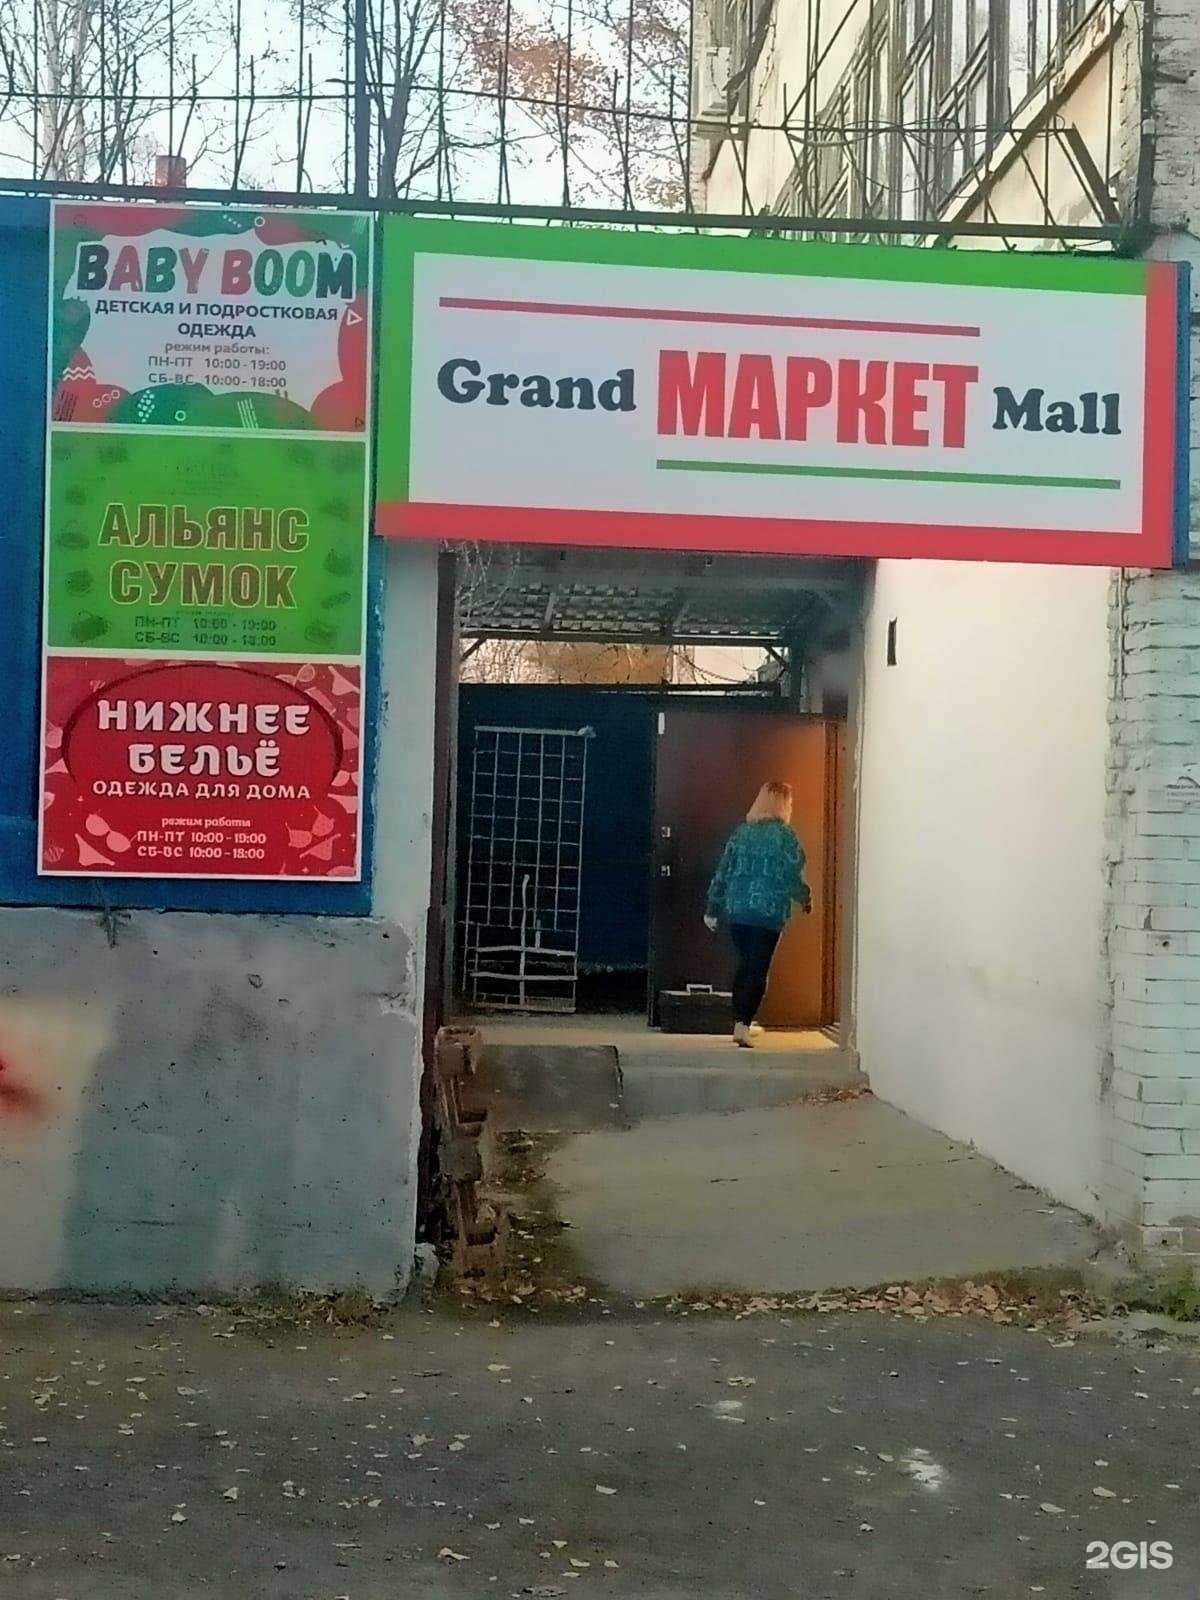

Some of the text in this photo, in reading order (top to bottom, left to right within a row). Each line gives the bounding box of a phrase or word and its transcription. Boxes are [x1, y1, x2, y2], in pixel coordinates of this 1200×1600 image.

[77, 244, 353, 299] BABY BOOM
[95, 299, 338, 320] ДЕТСКАЯ И ПОДРОСТКОВАЯ
[178, 323, 256, 338] ОДЕЖДА
[165, 343, 270, 355] режим работы:
[148, 356, 193, 367] ПН-ПТ
[204, 358, 240, 368] 10:00
[251, 360, 286, 371] 19:00
[148, 373, 194, 384] СБ-ВС
[204, 375, 240, 385] 10:00
[251, 377, 286, 388] 18:00
[437, 350, 1121, 448] Grand МАРКЕТ Mall
[98, 502, 310, 552] АЛЬЯНС
[109, 560, 298, 609] СУМОК
[98, 700, 311, 735] НИЖНЕЕ
[128, 740, 280, 777] БЕЛЬЁ
[93, 780, 310, 800] ОДЕЖДА ДЛЯ ДОМА
[137, 830, 185, 842] ПН-ПТ
[191, 832, 224, 843] 10:00
[137, 846, 183, 858] СБ-ВС
[189, 846, 222, 858] 10:00
[233, 848, 265, 859] 18:00
